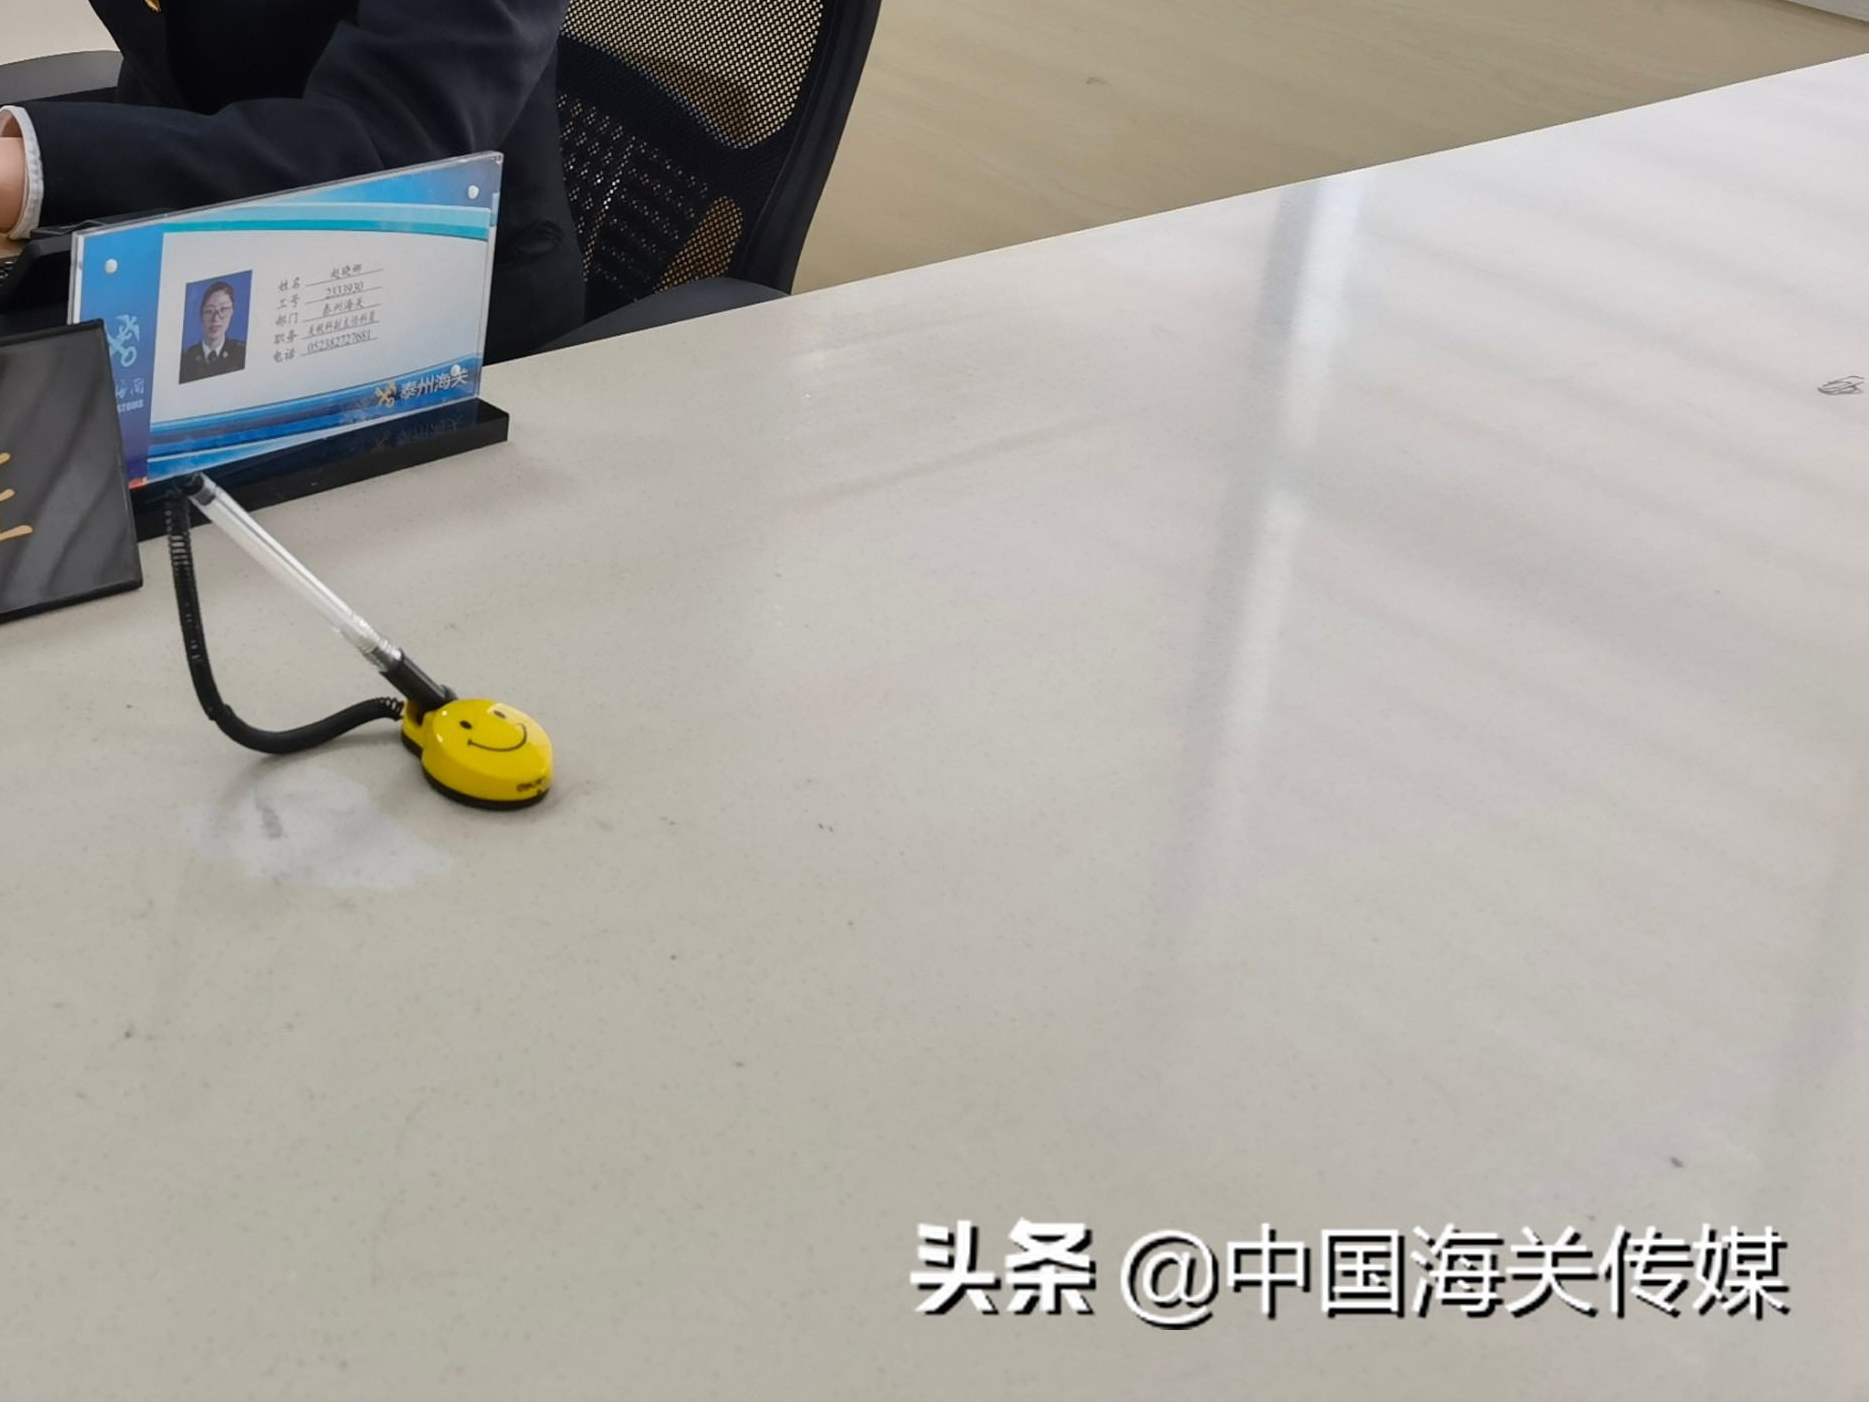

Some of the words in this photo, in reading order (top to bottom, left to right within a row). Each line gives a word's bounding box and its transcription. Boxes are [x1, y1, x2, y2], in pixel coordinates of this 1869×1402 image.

[277, 276, 301, 292] 姓名
[276, 293, 300, 310] 工号
[274, 312, 299, 328] 部门
[272, 329, 298, 346] 职务
[272, 346, 296, 364] 电话
[400, 368, 469, 399] 泰州海关
